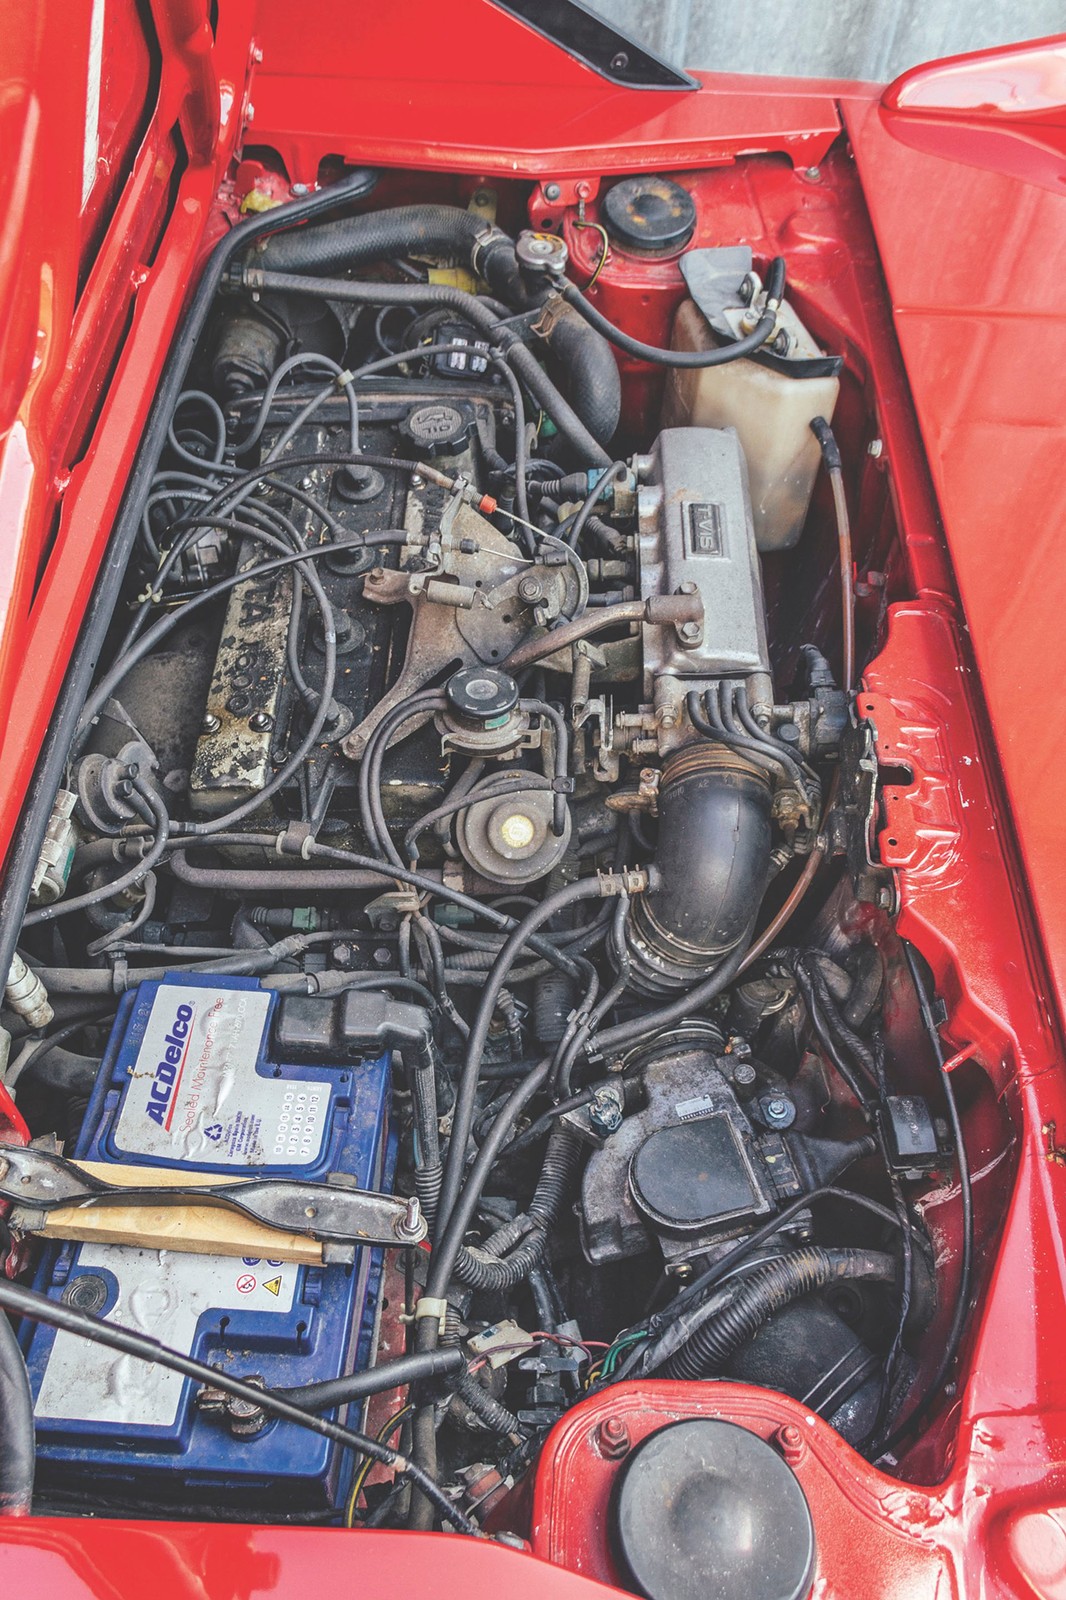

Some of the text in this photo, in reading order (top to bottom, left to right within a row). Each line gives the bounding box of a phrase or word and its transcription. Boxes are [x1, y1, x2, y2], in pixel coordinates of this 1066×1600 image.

[422, 425, 450, 434] OIL
[145, 1004, 193, 1126] ACDelco
[180, 997, 224, 1132] Sealed Maintenance Free
